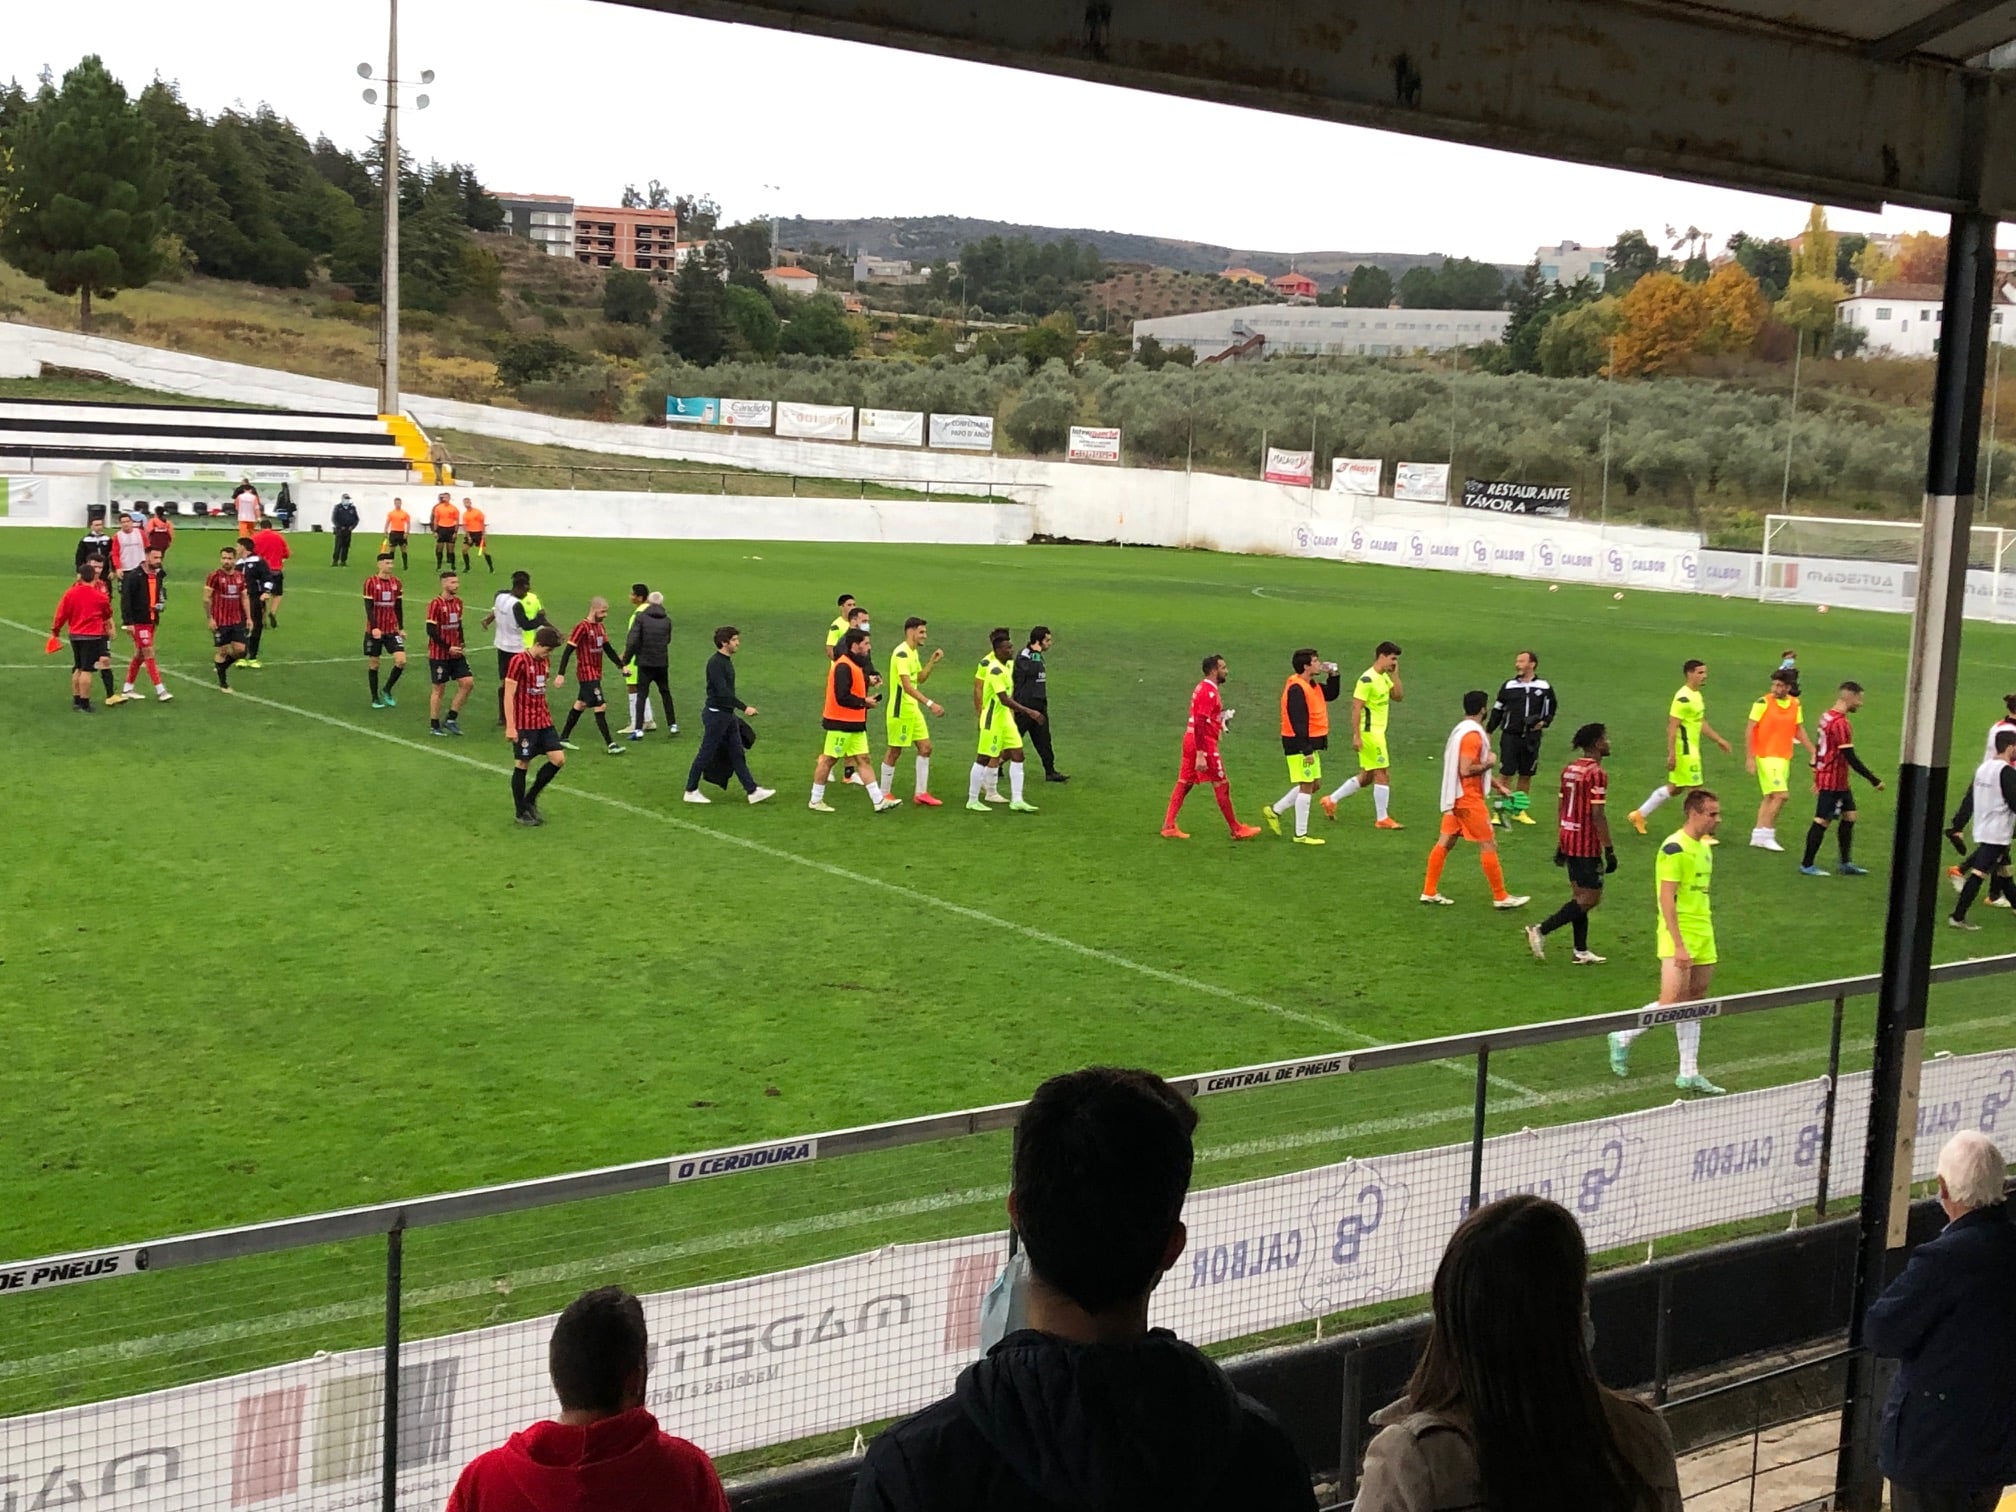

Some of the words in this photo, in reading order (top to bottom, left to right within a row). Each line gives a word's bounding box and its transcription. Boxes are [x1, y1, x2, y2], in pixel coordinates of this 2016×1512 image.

[1486, 483, 1572, 501] RESTAURANTE
[1464, 493, 1527, 514] TÁVORA
[1313, 535, 1338, 547] CALBOR
[1369, 539, 1398, 552] CALBOR
[1430, 544, 1460, 557] CALBOR
[1494, 549, 1525, 561] CALBOR
[1561, 553, 1593, 568] CALBOR
[1631, 559, 1667, 573] CALBOR
[1706, 566, 1742, 579] CALBOR
[1565, 782, 1575, 818] 7
[1642, 1013, 1653, 1025] O
[1654, 1003, 1718, 1024] CERDOURA
[1207, 1069, 1272, 1092] CENTRAL
[1274, 1066, 1294, 1081] DE
[1295, 1060, 1342, 1079] PNEUS
[677, 1162, 696, 1179] O
[698, 1143, 810, 1176] CERDOURA
[30, 1256, 120, 1286] PNEUS
